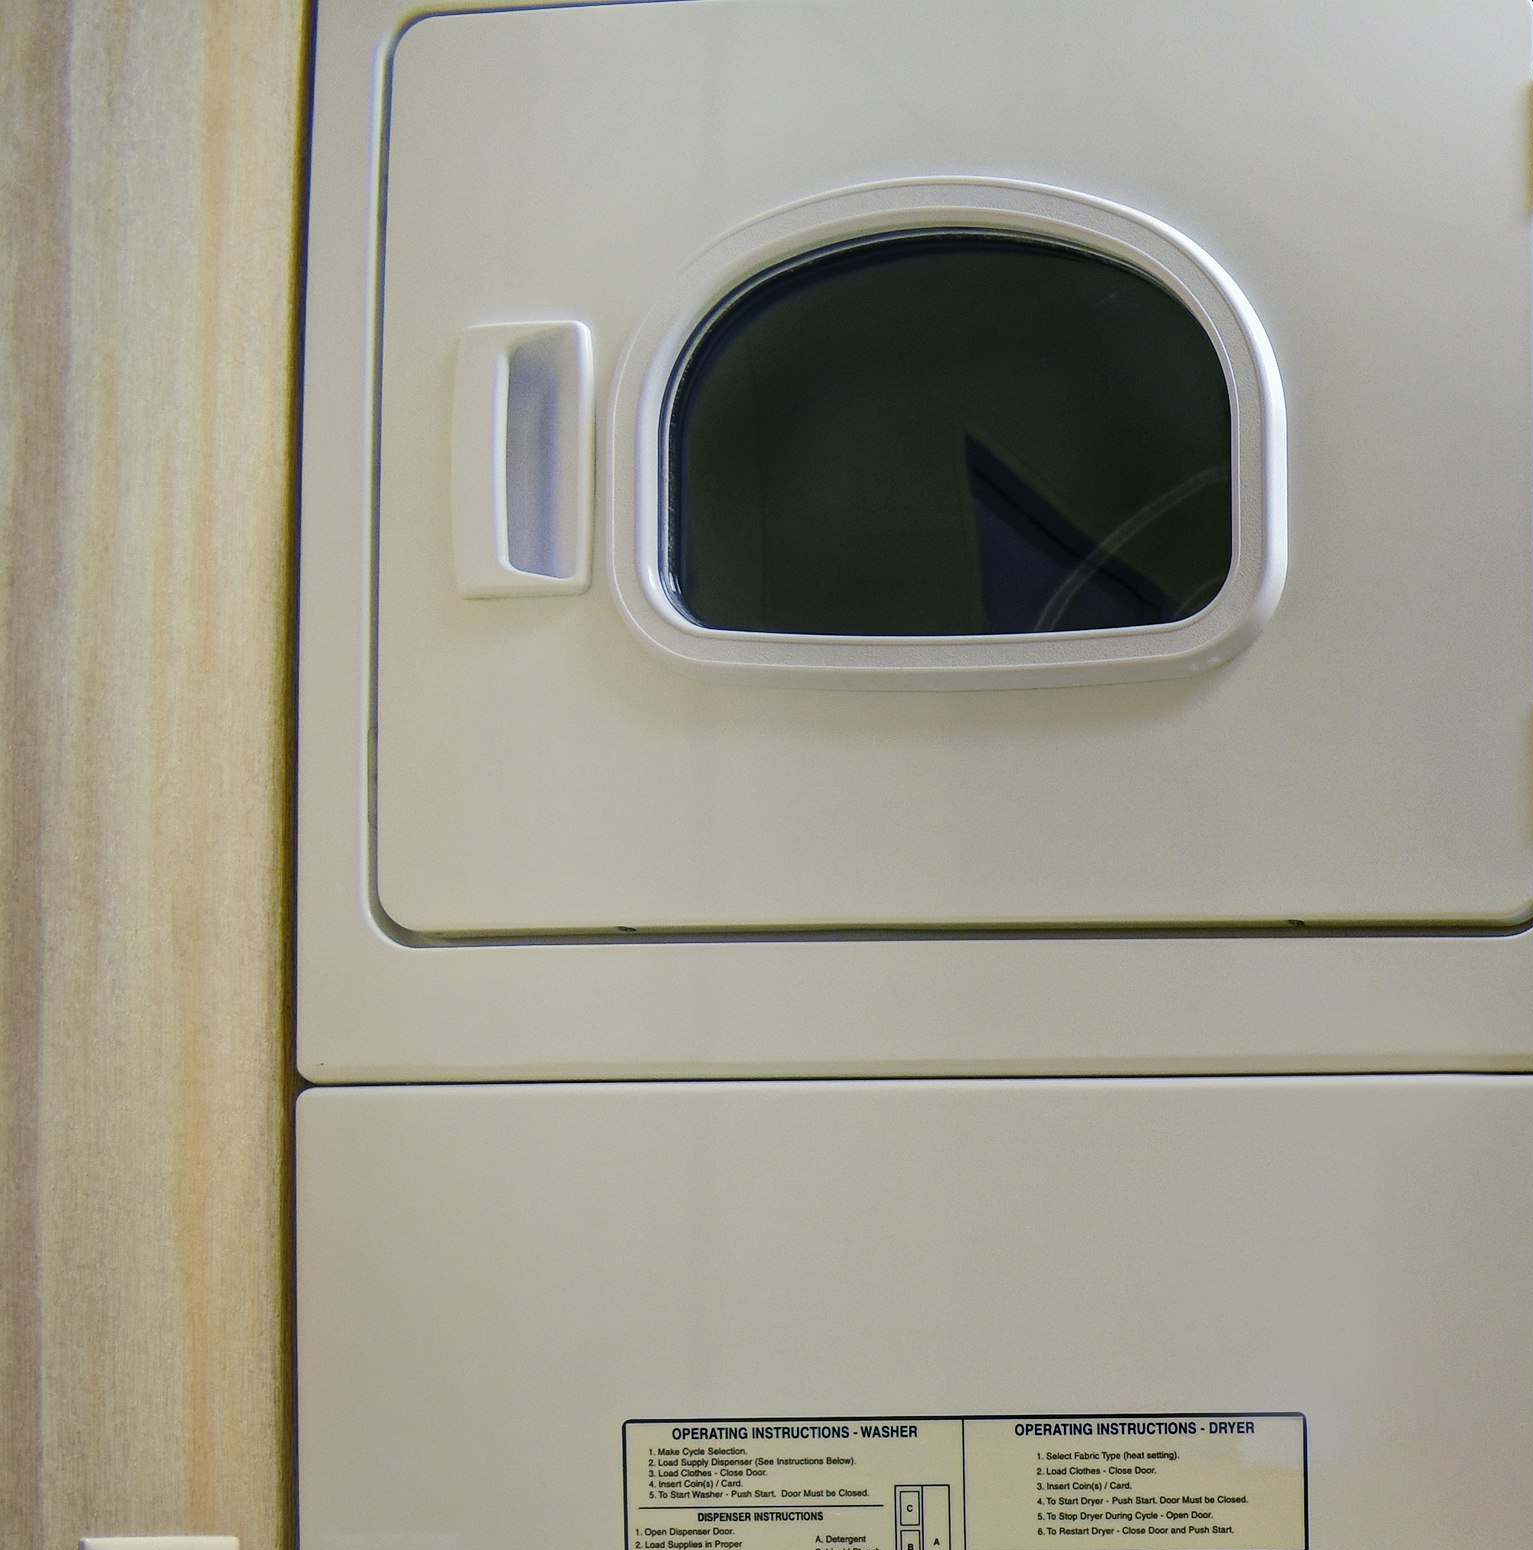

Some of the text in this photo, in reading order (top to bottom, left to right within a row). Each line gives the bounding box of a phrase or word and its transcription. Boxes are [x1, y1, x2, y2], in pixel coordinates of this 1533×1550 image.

[671, 1426, 748, 1440] OPERATING
[751, 1425, 850, 1439] INSTRUCTIONS
[859, 1424, 918, 1438] WASHER
[1013, 1422, 1093, 1436] OPERATING
[1096, 1421, 1197, 1435] INSTRUCTIONS
[1208, 1421, 1255, 1434] DRYER
[648, 1447, 656, 1456] 1.
[681, 1446, 705, 1457] Cycle
[706, 1446, 748, 1455] Selection.
[1036, 1452, 1044, 1460] 1.
[1045, 1451, 1072, 1460] Select
[1100, 1450, 1121, 1461] Type
[1122, 1450, 1145, 1461] (heat
[1146, 1450, 1179, 1461] setting).
[647, 1458, 656, 1467] 2.
[680, 1457, 709, 1468] Supply
[710, 1457, 753, 1467] Dispenser
[753, 1456, 774, 1467] (See
[825, 1456, 856, 1466] Below).
[906, 1504, 914, 1512] C
[696, 1510, 824, 1522] DISPENSER INSTRUCTIONS
[814, 1534, 866, 1545] A. Detergent
[933, 1538, 940, 1546] A
[907, 1543, 914, 1550] B
